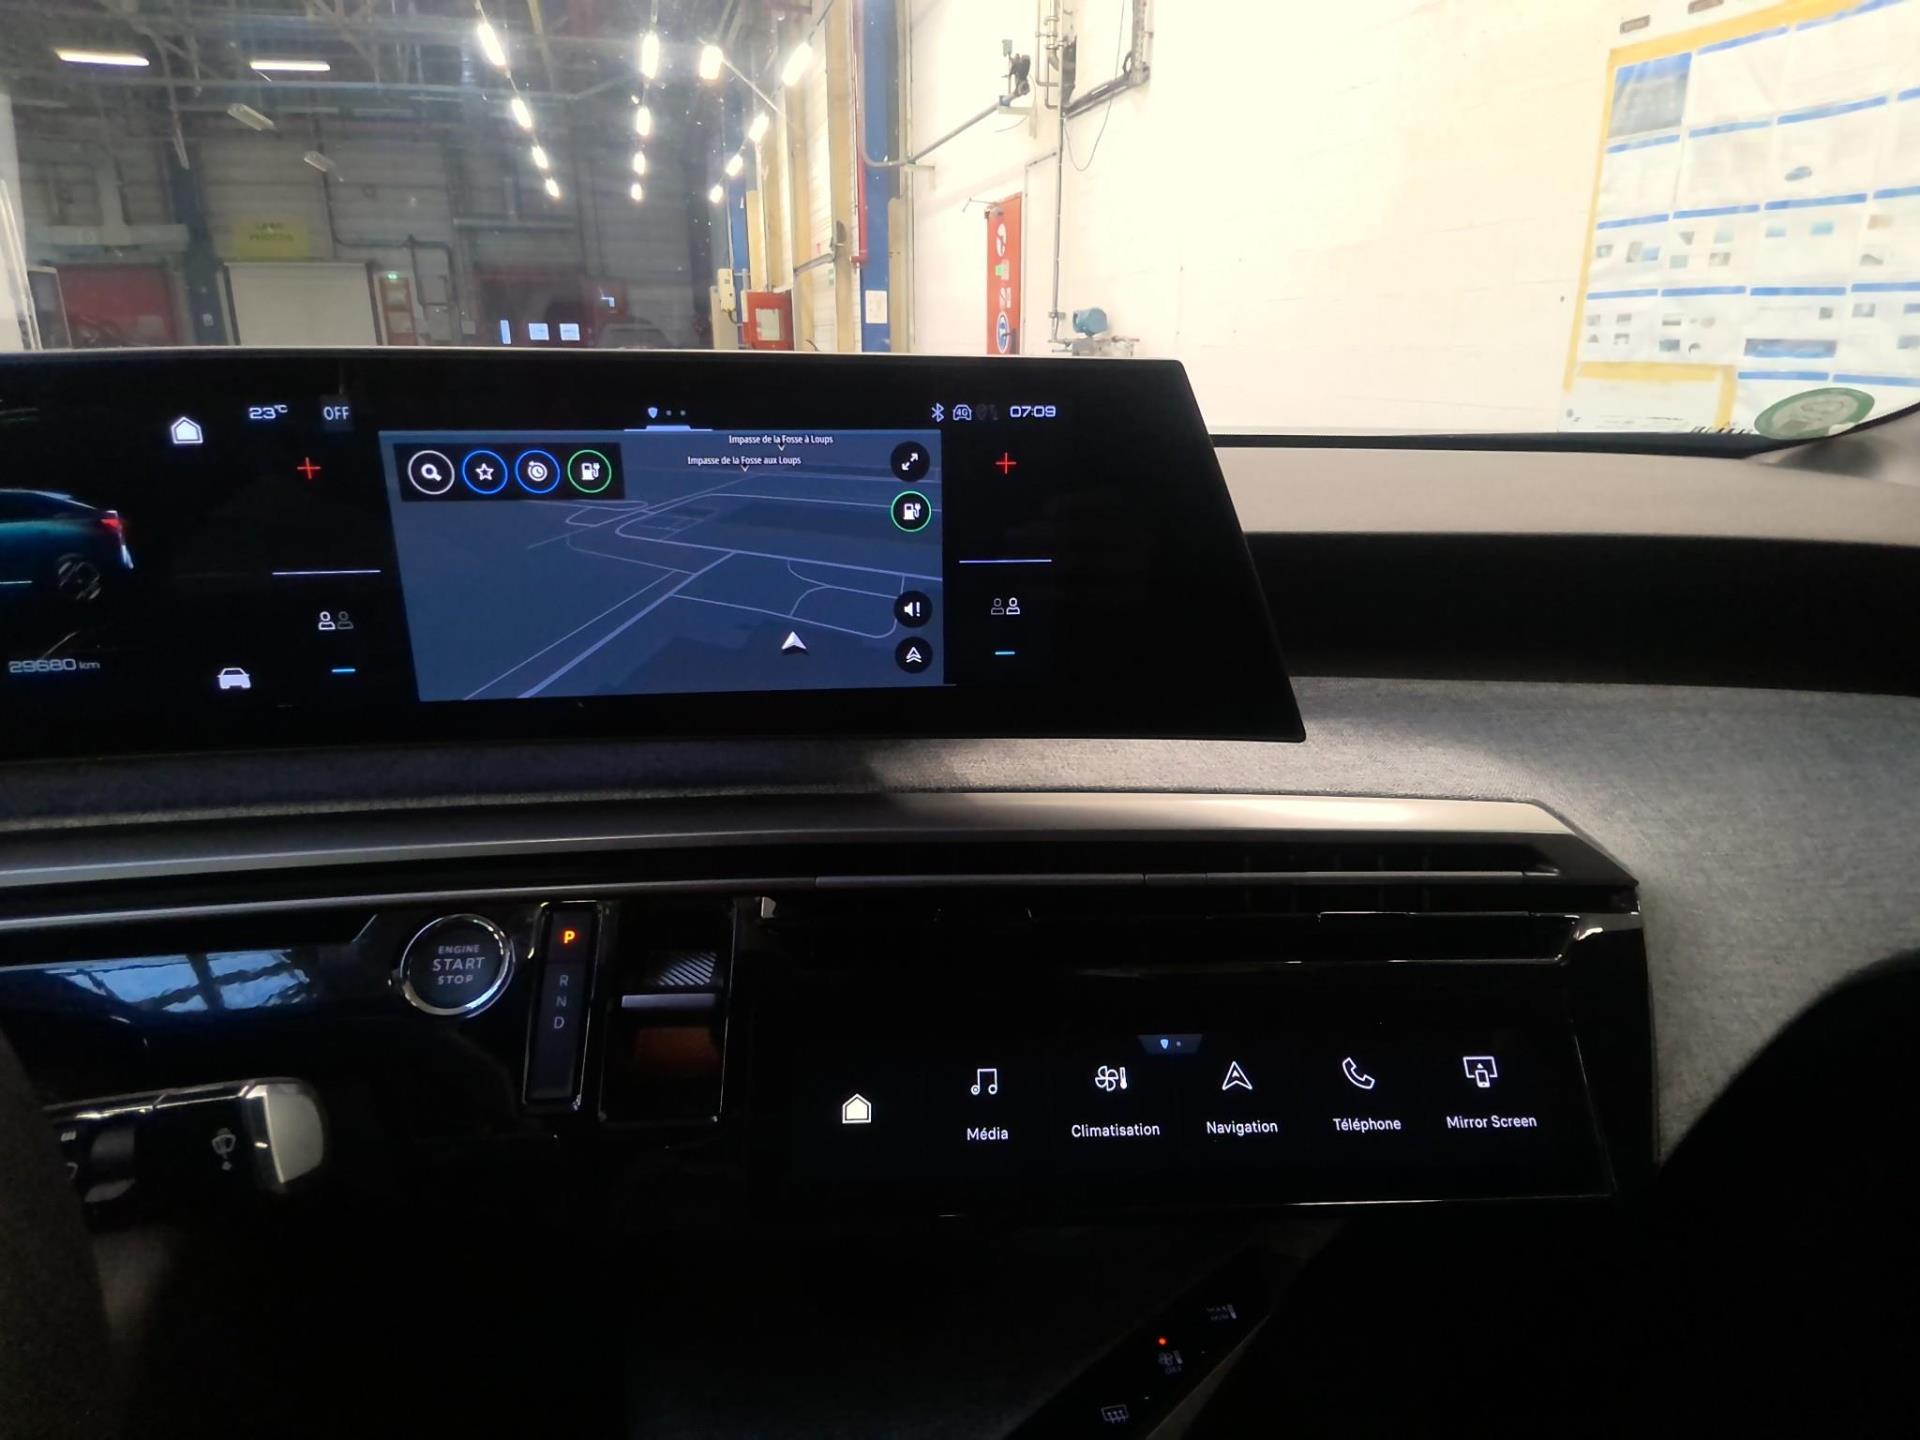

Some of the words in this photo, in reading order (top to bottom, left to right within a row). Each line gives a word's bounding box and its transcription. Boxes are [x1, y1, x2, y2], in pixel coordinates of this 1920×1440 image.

[323, 406, 350, 421] OFF
[955, 408, 968, 417] 4G
[1009, 405, 1057, 418] 07:09
[728, 434, 761, 445] Impasse
[762, 434, 773, 444] de
[773, 434, 781, 444] la
[781, 434, 803, 444] Fosse
[804, 435, 810, 444] à
[811, 434, 834, 445] Loups
[687, 455, 720, 466] Impasse
[720, 455, 732, 465] de
[732, 455, 740, 465] la
[741, 455, 763, 465] Fosse
[763, 456, 778, 465] aux
[778, 455, 802, 466] Loups
[8, 657, 77, 674] 29680
[78, 660, 101, 671] km
[563, 930, 576, 944] P
[437, 944, 480, 955] ENGINE
[432, 956, 486, 972] START
[437, 975, 474, 985] STOP
[559, 974, 569, 987] R
[556, 995, 567, 1008] N
[553, 1016, 565, 1029] D
[1206, 1119, 1278, 1137] Navigation
[1332, 1116, 1402, 1134] Téléphone
[1446, 1115, 1488, 1130] Mirror
[1490, 1114, 1537, 1129] Screen
[966, 1126, 1009, 1141] Média
[1071, 1122, 1161, 1139] Climatisation
